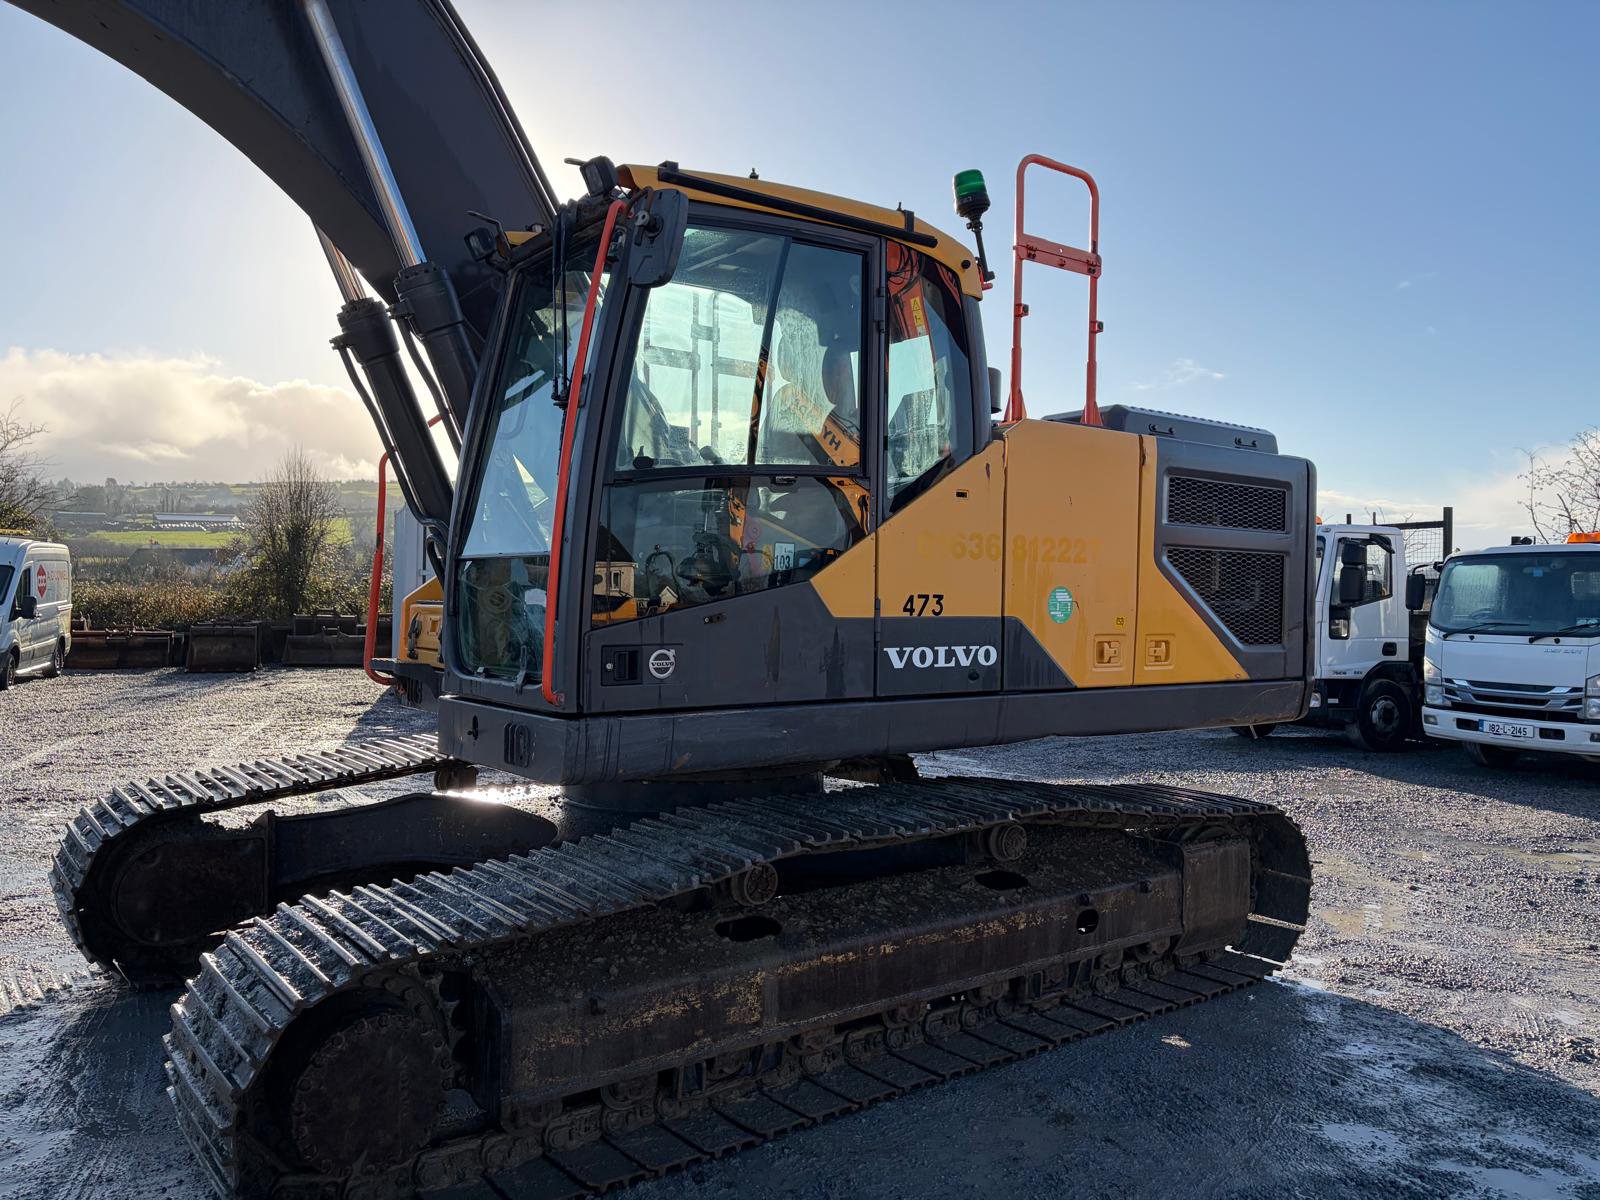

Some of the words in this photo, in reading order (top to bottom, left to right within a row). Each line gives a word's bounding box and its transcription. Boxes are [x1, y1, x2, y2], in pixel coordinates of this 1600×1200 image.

[775, 555, 791, 570] 103
[903, 594, 944, 616] 473
[883, 645, 998, 669] VOLVO
[1488, 723, 1528, 736] 182-L-2145
